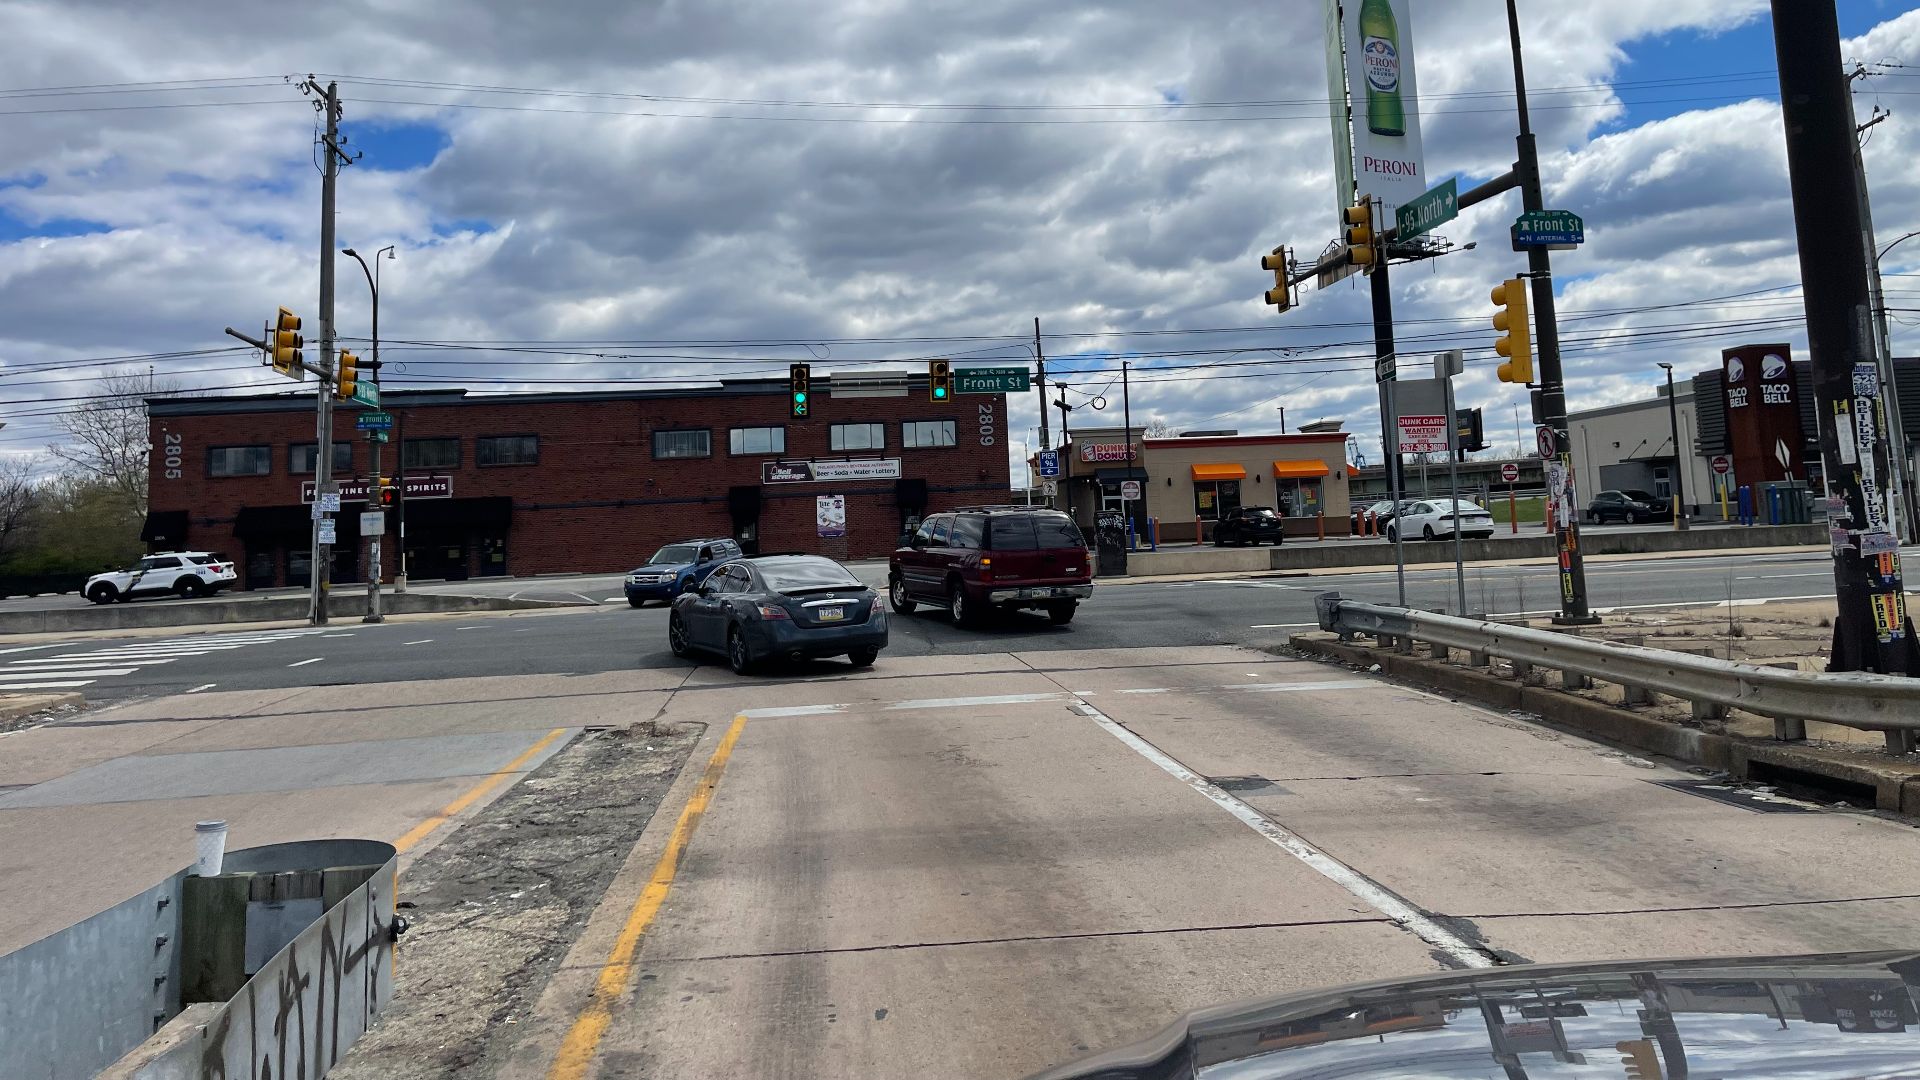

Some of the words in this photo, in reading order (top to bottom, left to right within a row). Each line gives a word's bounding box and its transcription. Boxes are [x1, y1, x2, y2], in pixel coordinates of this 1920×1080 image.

[1365, 54, 1398, 69] PERONI
[1364, 156, 1416, 176] PERONI
[1380, 174, 1402, 182] ITALIA
[1397, 210, 1415, 237] I-95
[1418, 195, 1443, 225] North
[1533, 219, 1564, 232] Front
[1568, 218, 1580, 232] St
[963, 377, 1001, 390] Front
[1007, 376, 1022, 389] St
[1727, 387, 1747, 398] TACO
[1760, 384, 1790, 394] TACO
[1730, 398, 1748, 409] BELL
[1763, 394, 1791, 404] BELL
[978, 403, 995, 446] 2809
[1400, 418, 1421, 426] JUNK
[1423, 417, 1446, 426] CARS
[1401, 443, 1446, 451] 267-369-3600
[165, 433, 182, 480] 2805
[1041, 452, 1056, 460] PIER
[875, 467, 896, 475] Lottery
[406, 483, 447, 492] SPIRITS
[1874, 595, 1889, 628] FRED
